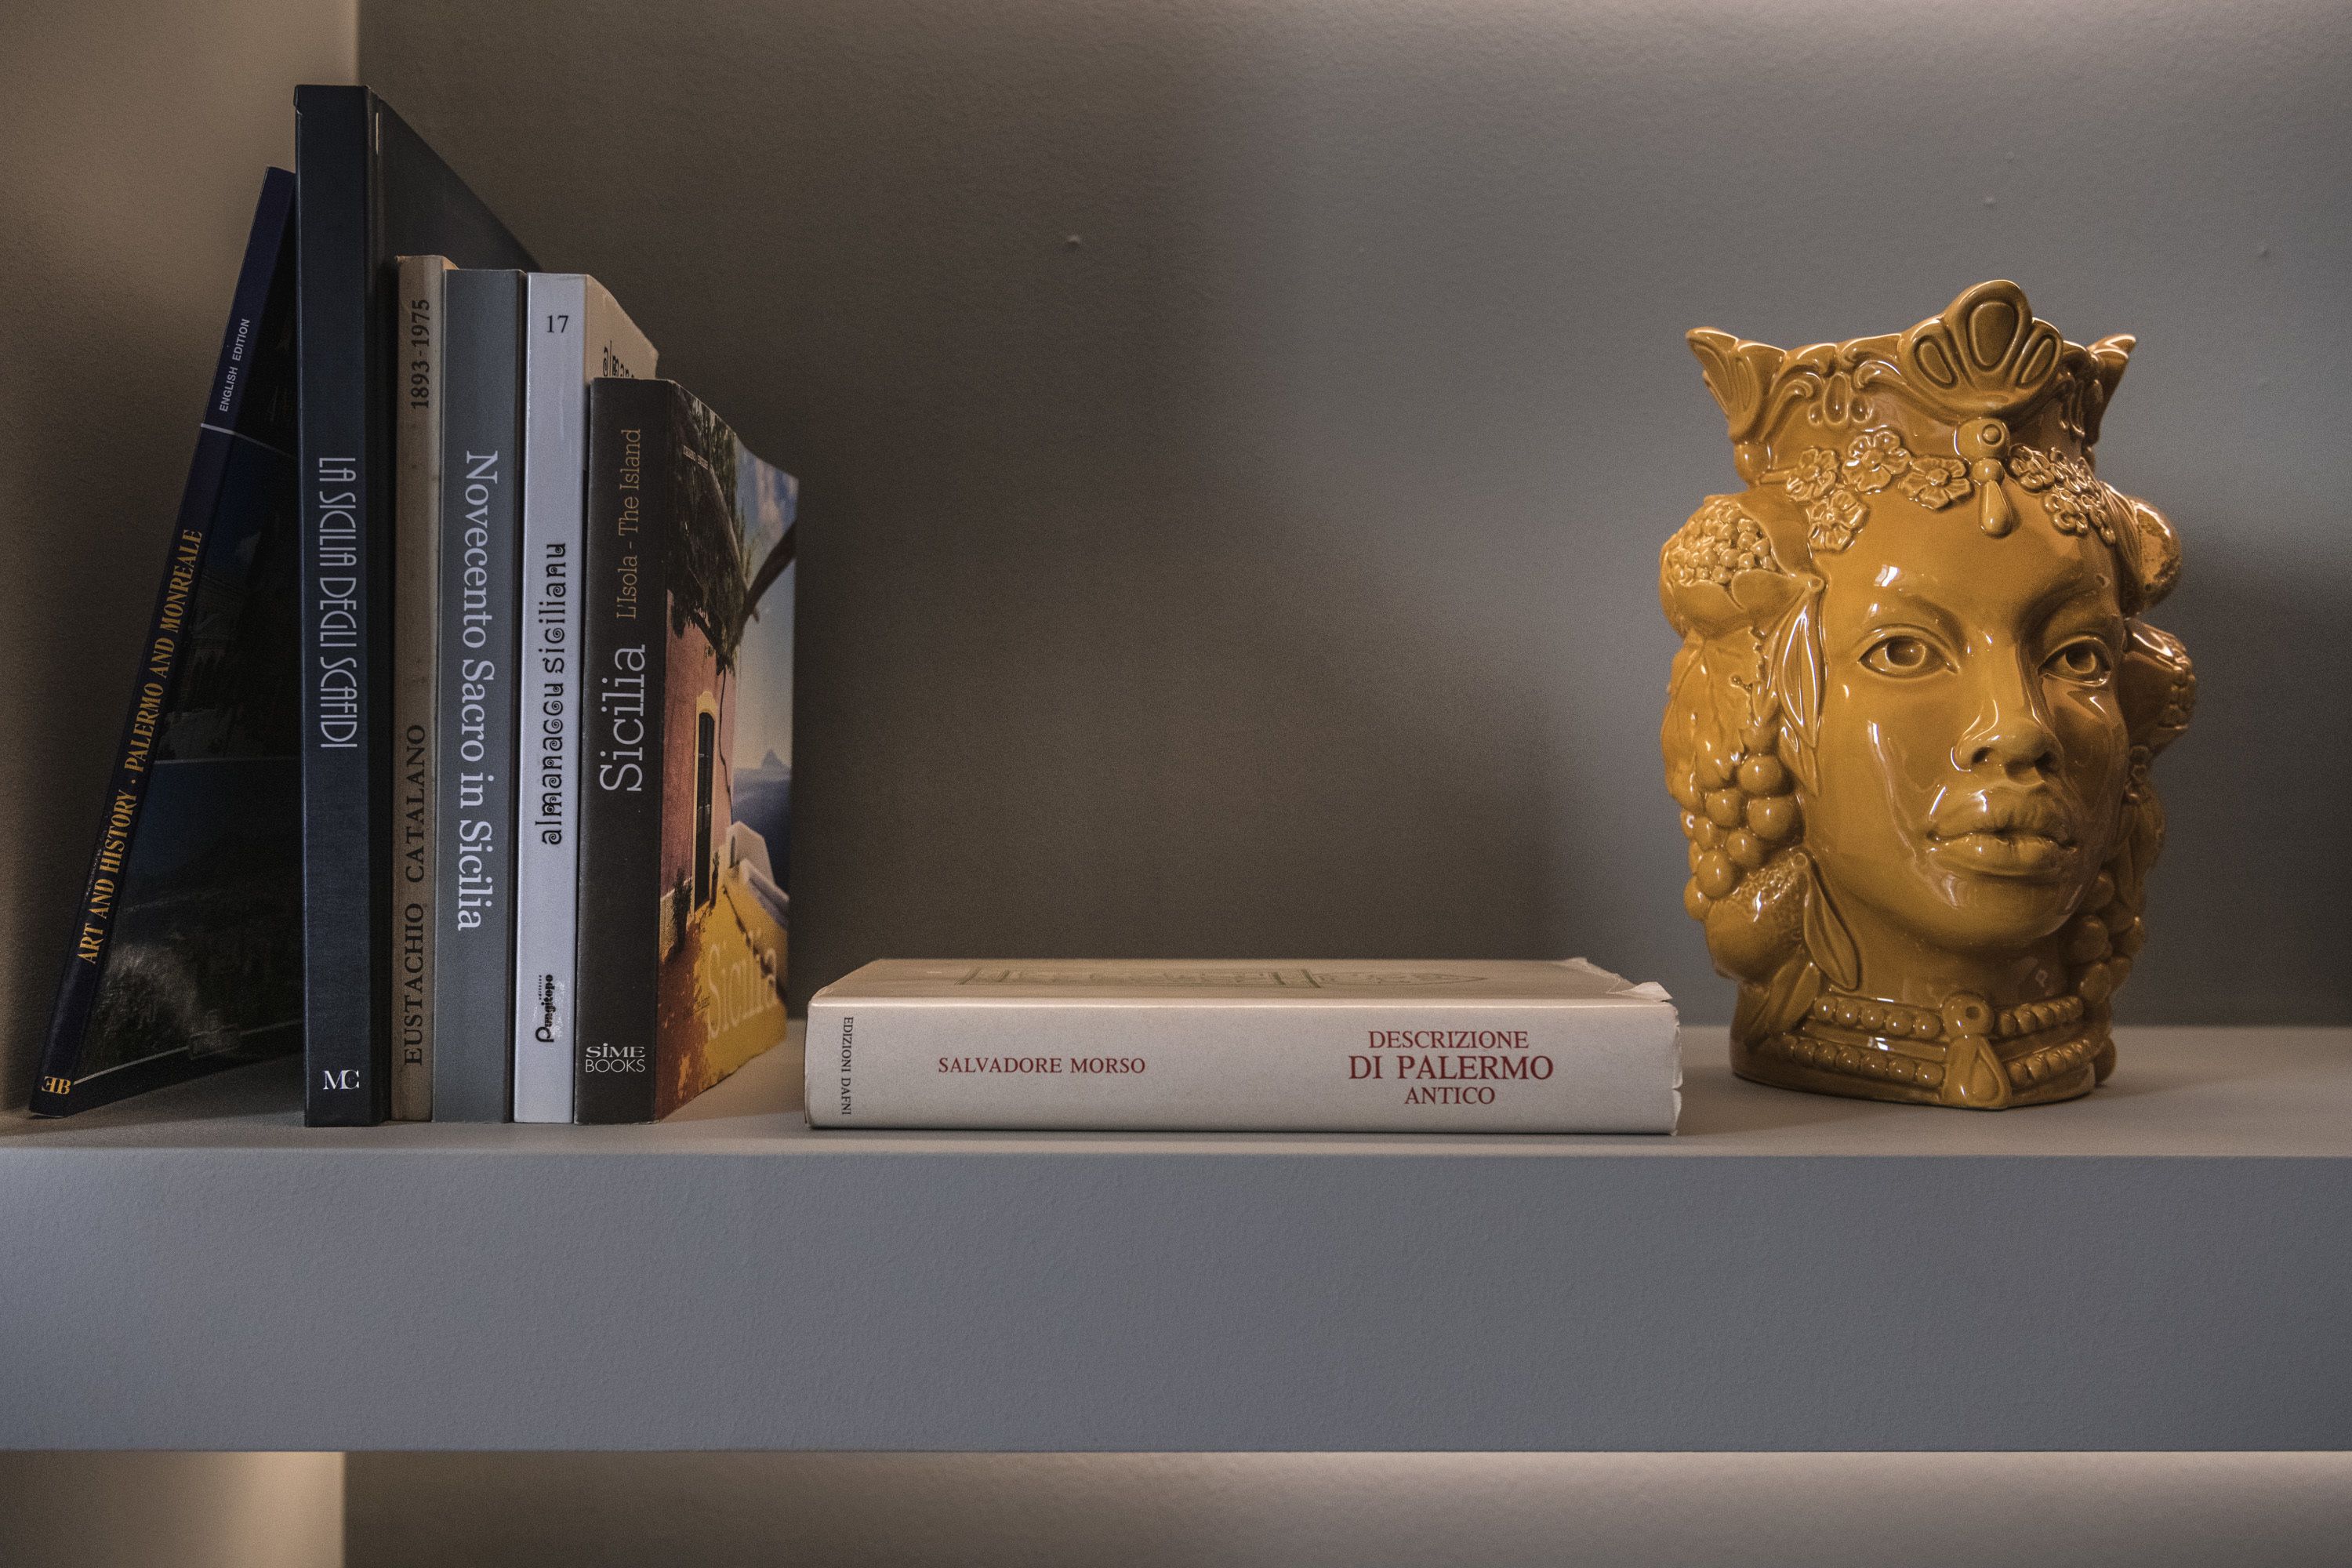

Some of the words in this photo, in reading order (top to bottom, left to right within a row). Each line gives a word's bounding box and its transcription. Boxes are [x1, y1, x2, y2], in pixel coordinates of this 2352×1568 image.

[546, 315, 569, 333] 17
[220, 367, 238, 412] ENGLISH
[232, 319, 249, 361] EDITION
[319, 458, 356, 481] LA
[619, 430, 640, 489] Island
[320, 492, 356, 566] SICILIA
[619, 497, 639, 535] The
[160, 530, 201, 633] MONREALE
[463, 451, 498, 648] Novecento
[320, 578, 356, 647] DEGLI
[539, 543, 566, 673] sicilianu
[616, 554, 637, 619] L'Isola
[149, 635, 176, 681] AND
[125, 684, 162, 771] PALERMO
[321, 657, 358, 747] SCAFIDI
[461, 660, 495, 761] Sacro
[600, 644, 645, 791] Sicilia
[461, 773, 494, 808] in
[535, 683, 564, 844] almanaccu
[99, 789, 138, 874] HISTORY
[406, 725, 425, 882] CATALANO
[88, 877, 116, 920] AND
[458, 820, 492, 931] Sicilia
[76, 922, 106, 965] ART
[405, 904, 423, 1065] EUSTACHIO
[535, 975, 556, 1042] Pungitopo
[586, 1059, 645, 1073] BOOKS
[841, 1018, 853, 1072] EDIZIONI
[939, 1058, 1062, 1073] SALVADORE
[1072, 1058, 1145, 1073] MORSO
[1350, 1056, 1381, 1079] DI
[1399, 1056, 1553, 1080] PALERMO
[1369, 1030, 1529, 1049] DESCRIZIONE
[324, 1070, 359, 1089] MC
[842, 1078, 851, 1115] DAFNI
[1405, 1087, 1495, 1104] ANTICO
